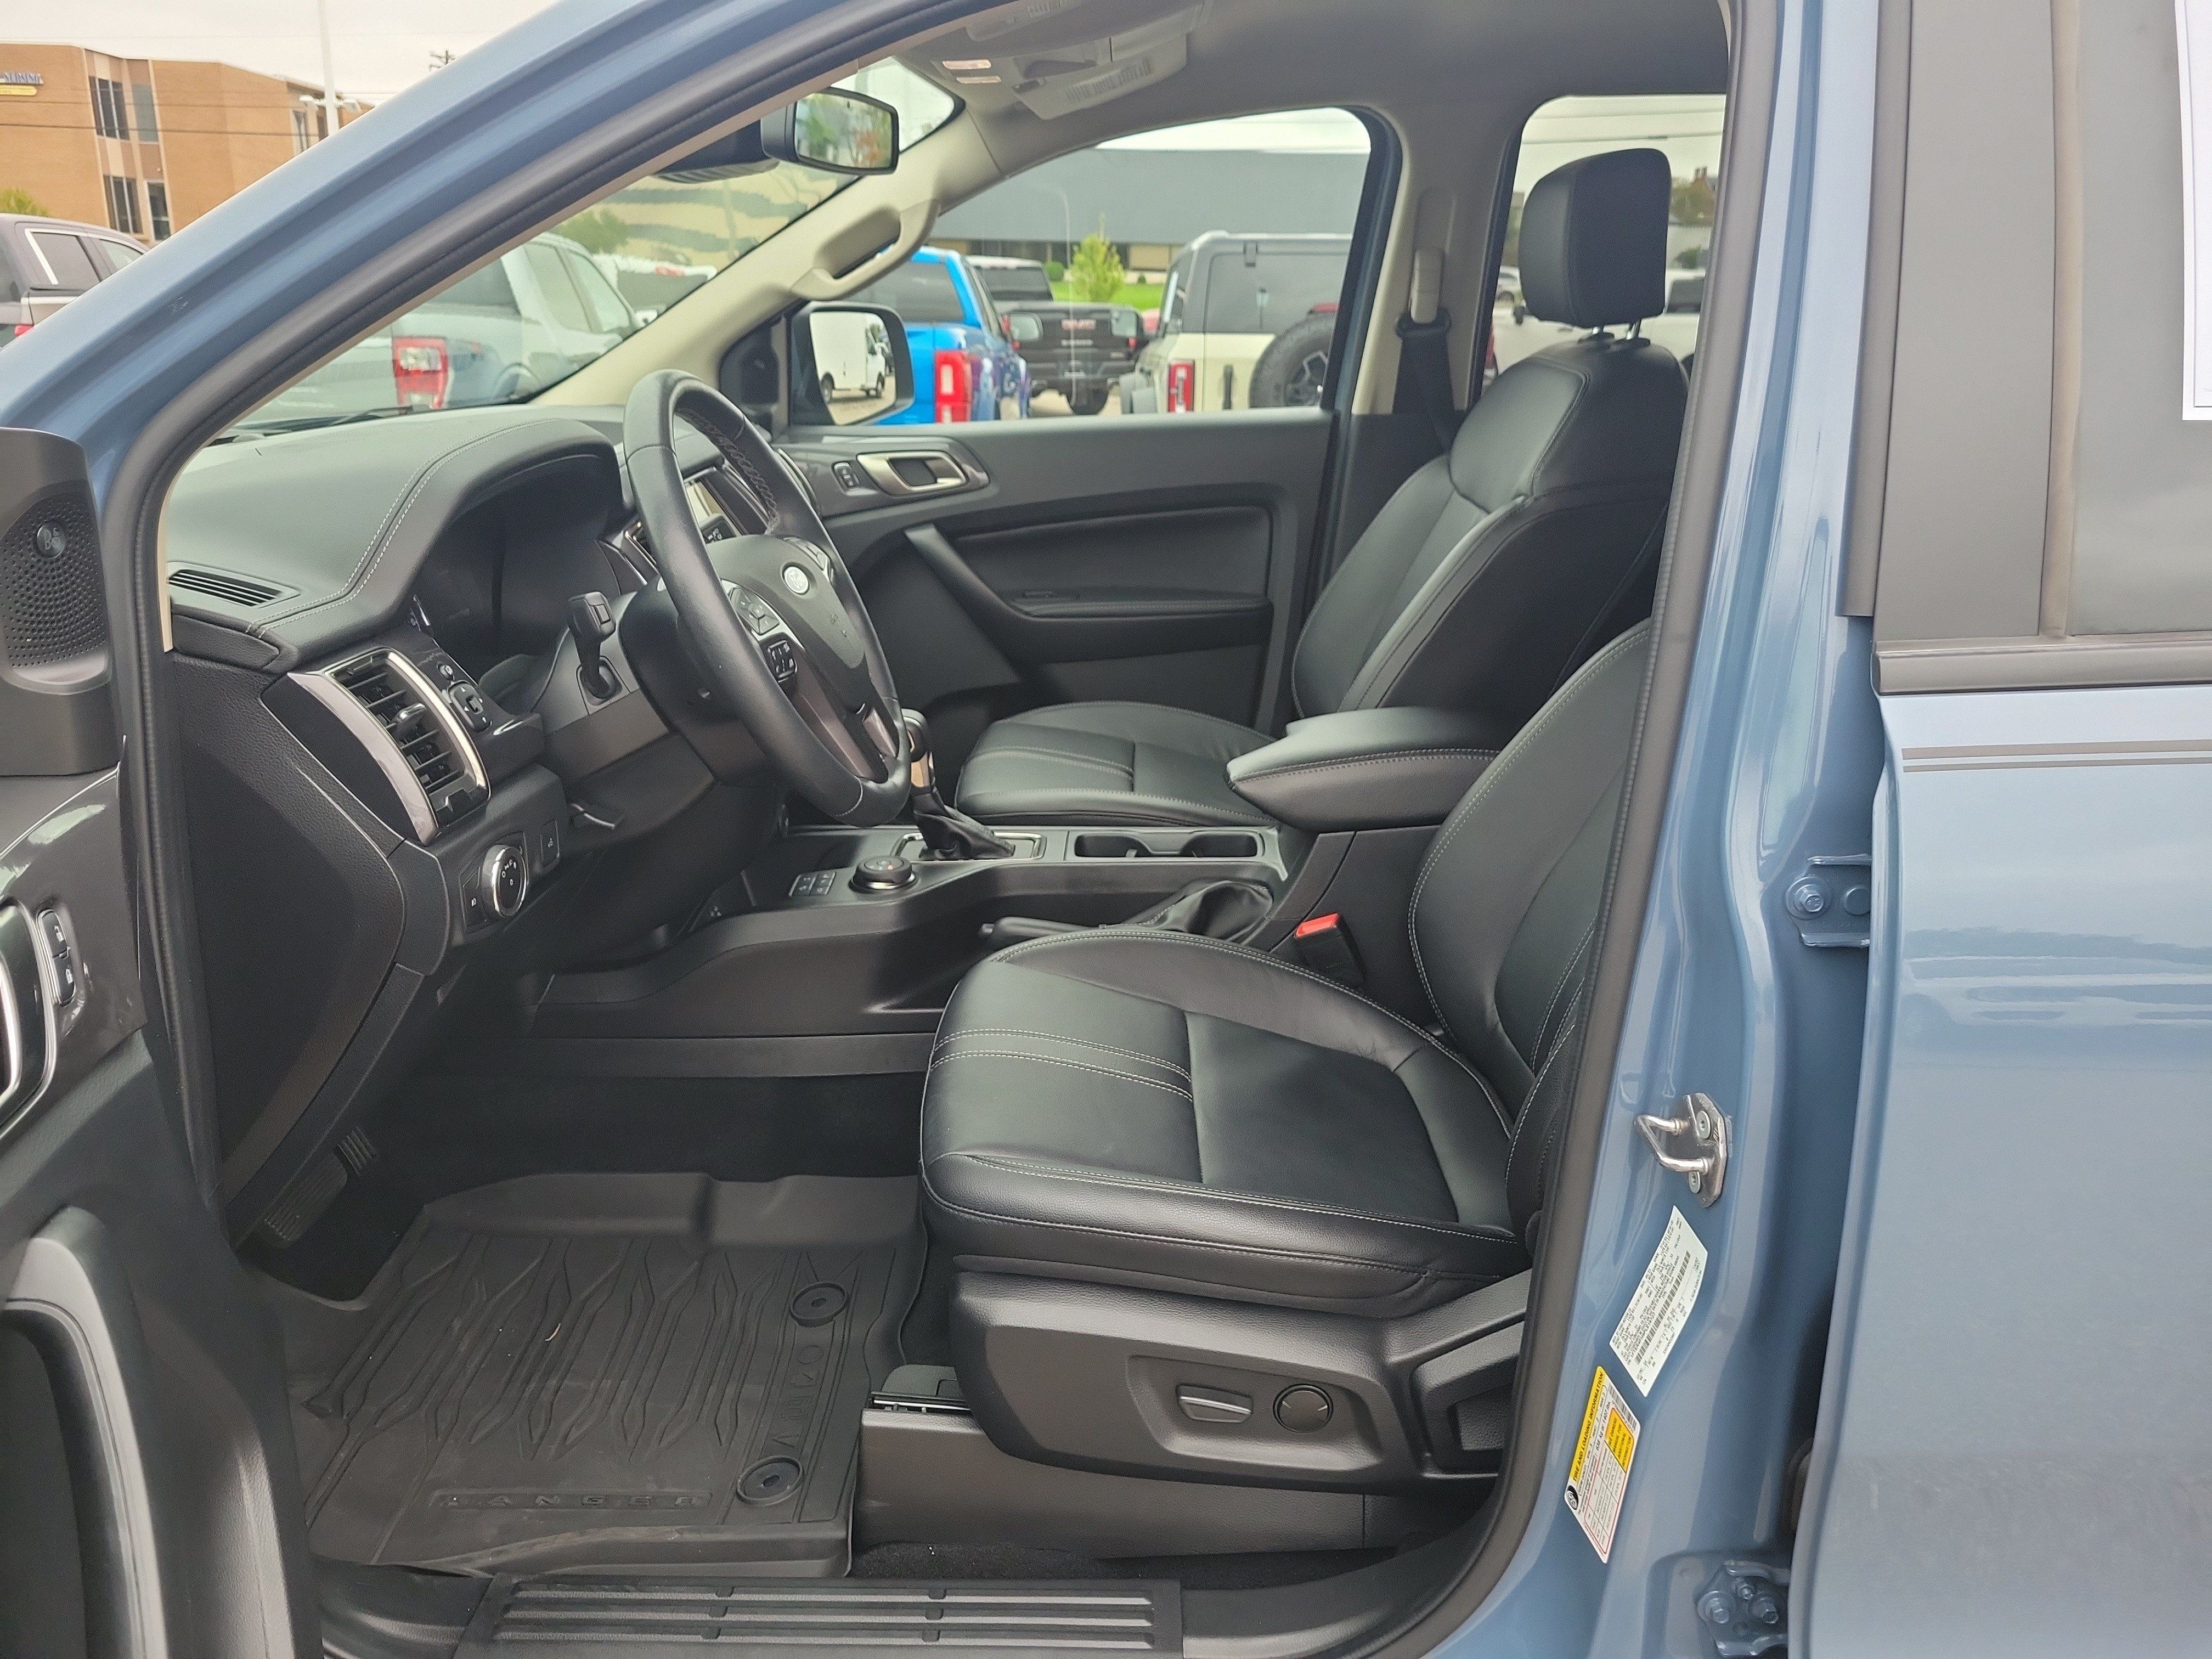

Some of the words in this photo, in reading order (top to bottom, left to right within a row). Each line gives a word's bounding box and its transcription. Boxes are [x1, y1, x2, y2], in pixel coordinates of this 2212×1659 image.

[1580, 1418, 1591, 1452] LOADING
[1588, 1370, 1603, 1421] INFORMATION
[1598, 1429, 1603, 1440] kg
[1600, 1423, 1605, 1432] or
[1616, 1430, 1626, 1460] ADDITIONAL
[1621, 1435, 1632, 1468] INFORMATION
